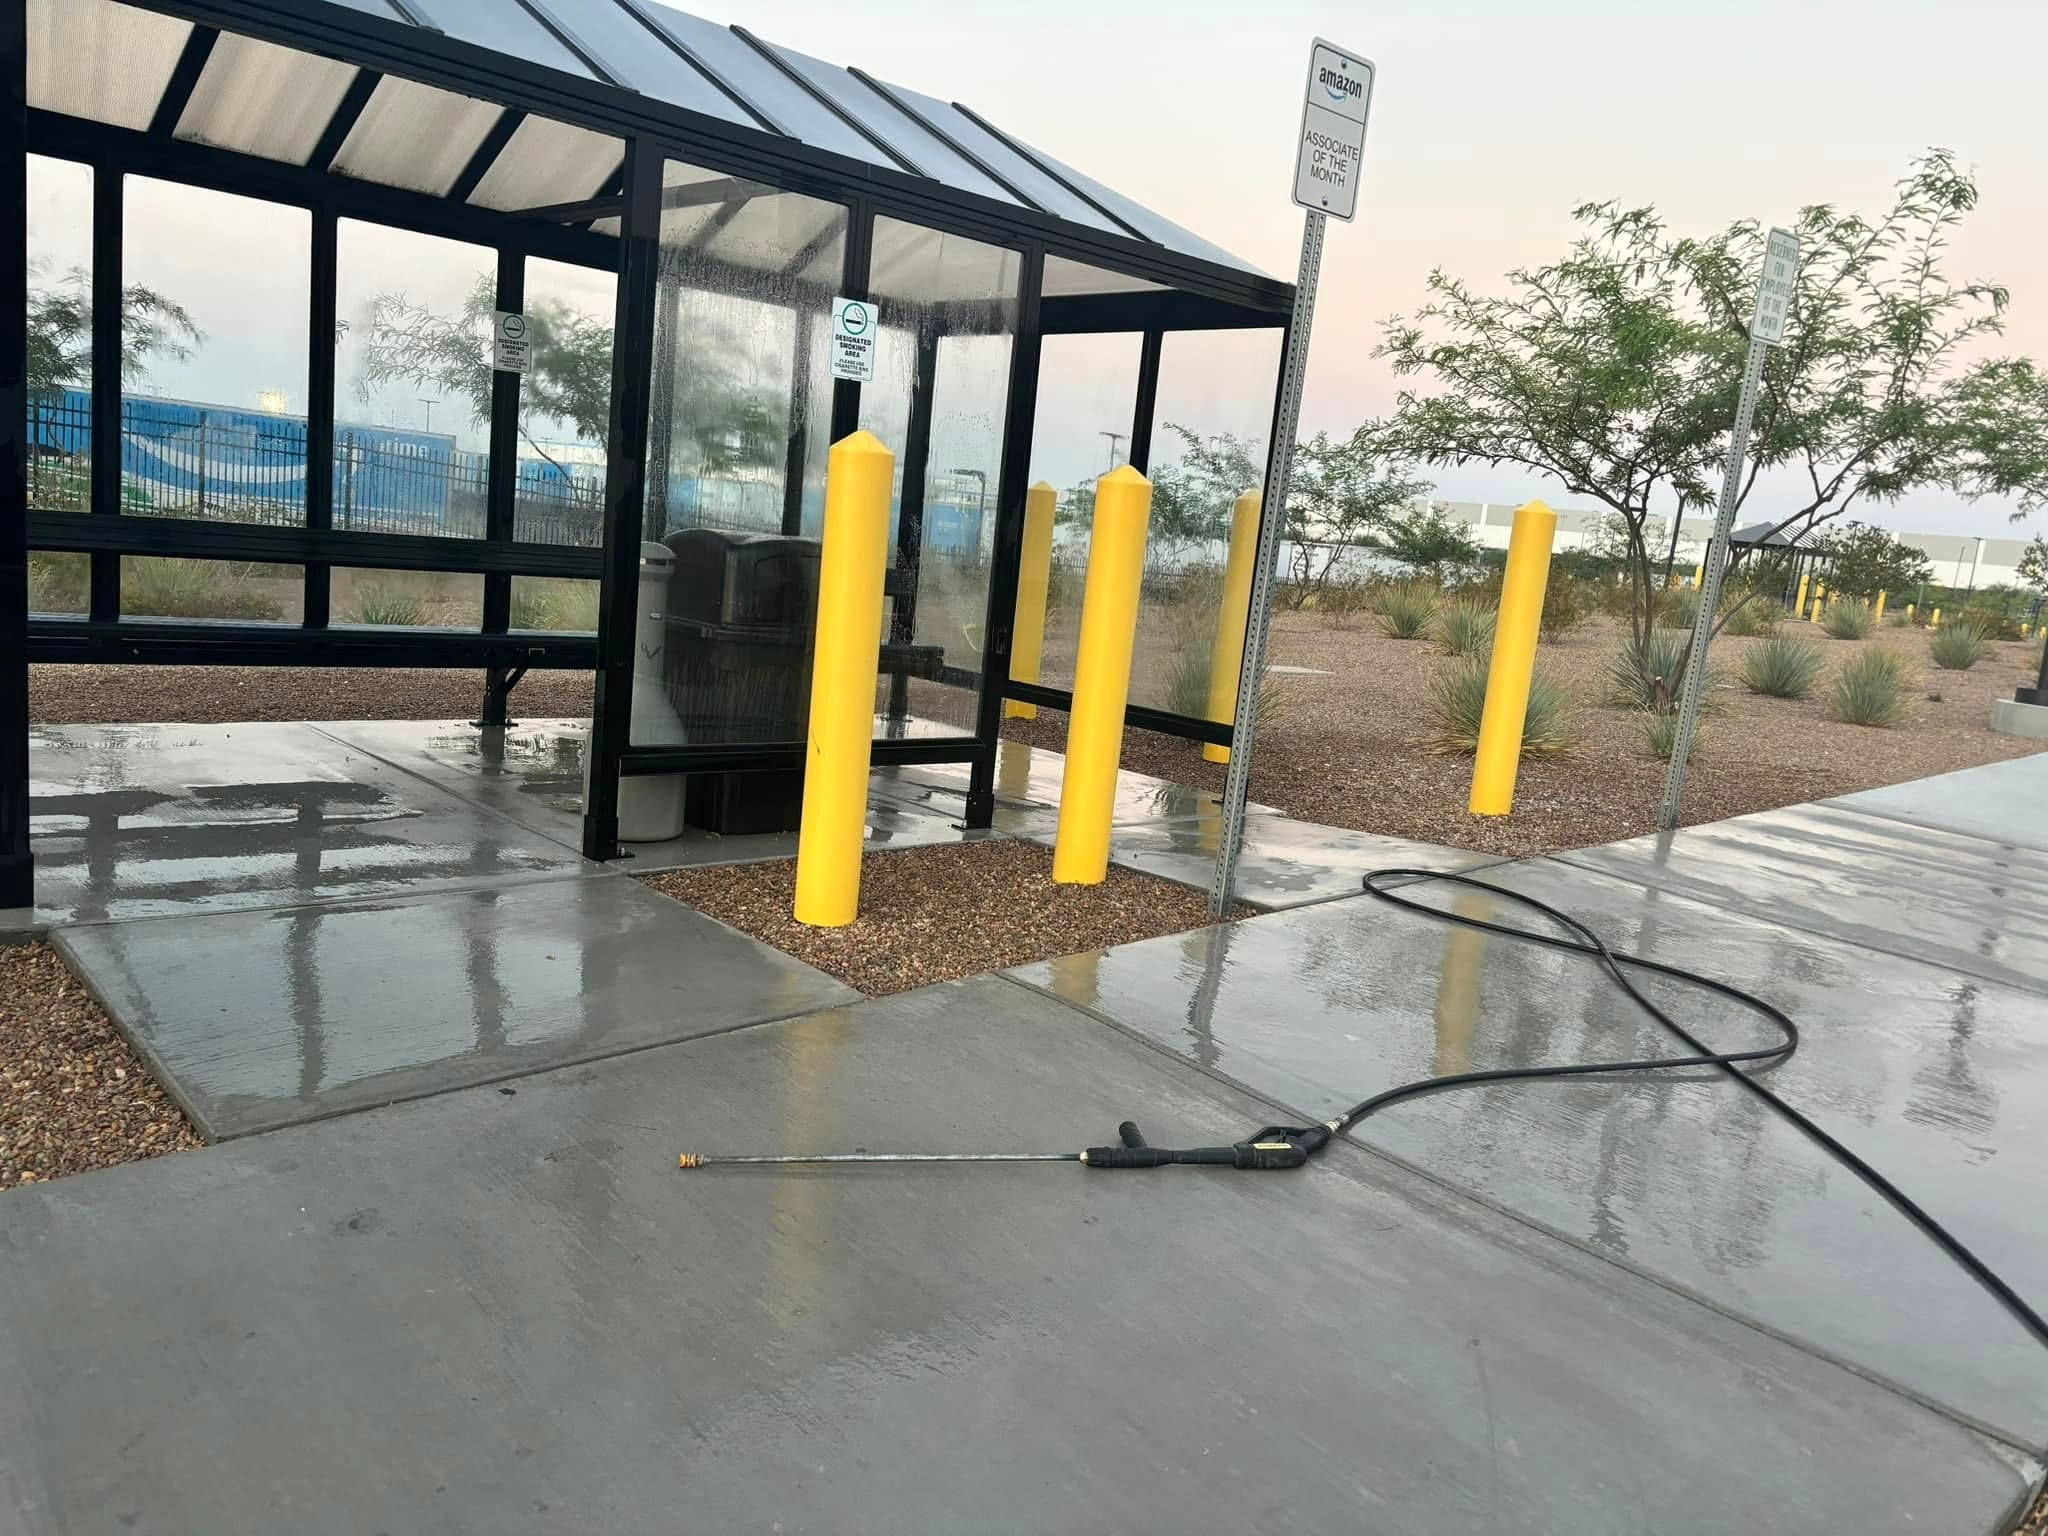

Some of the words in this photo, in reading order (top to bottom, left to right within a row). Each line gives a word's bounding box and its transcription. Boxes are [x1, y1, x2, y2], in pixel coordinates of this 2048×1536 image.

[1319, 67, 1362, 98] amazon
[1305, 130, 1359, 161] ASSOCIATE
[1313, 150, 1327, 164] OF
[1329, 155, 1348, 173] THE
[1310, 164, 1346, 188] MONTH
[1769, 240, 1797, 262] RESERVED
[1774, 261, 1785, 277] FOR
[1760, 314, 1778, 331] MONTH
[835, 334, 872, 346] DESIGNATED
[839, 342, 866, 352] SMOKING
[844, 350, 860, 358] AREA
